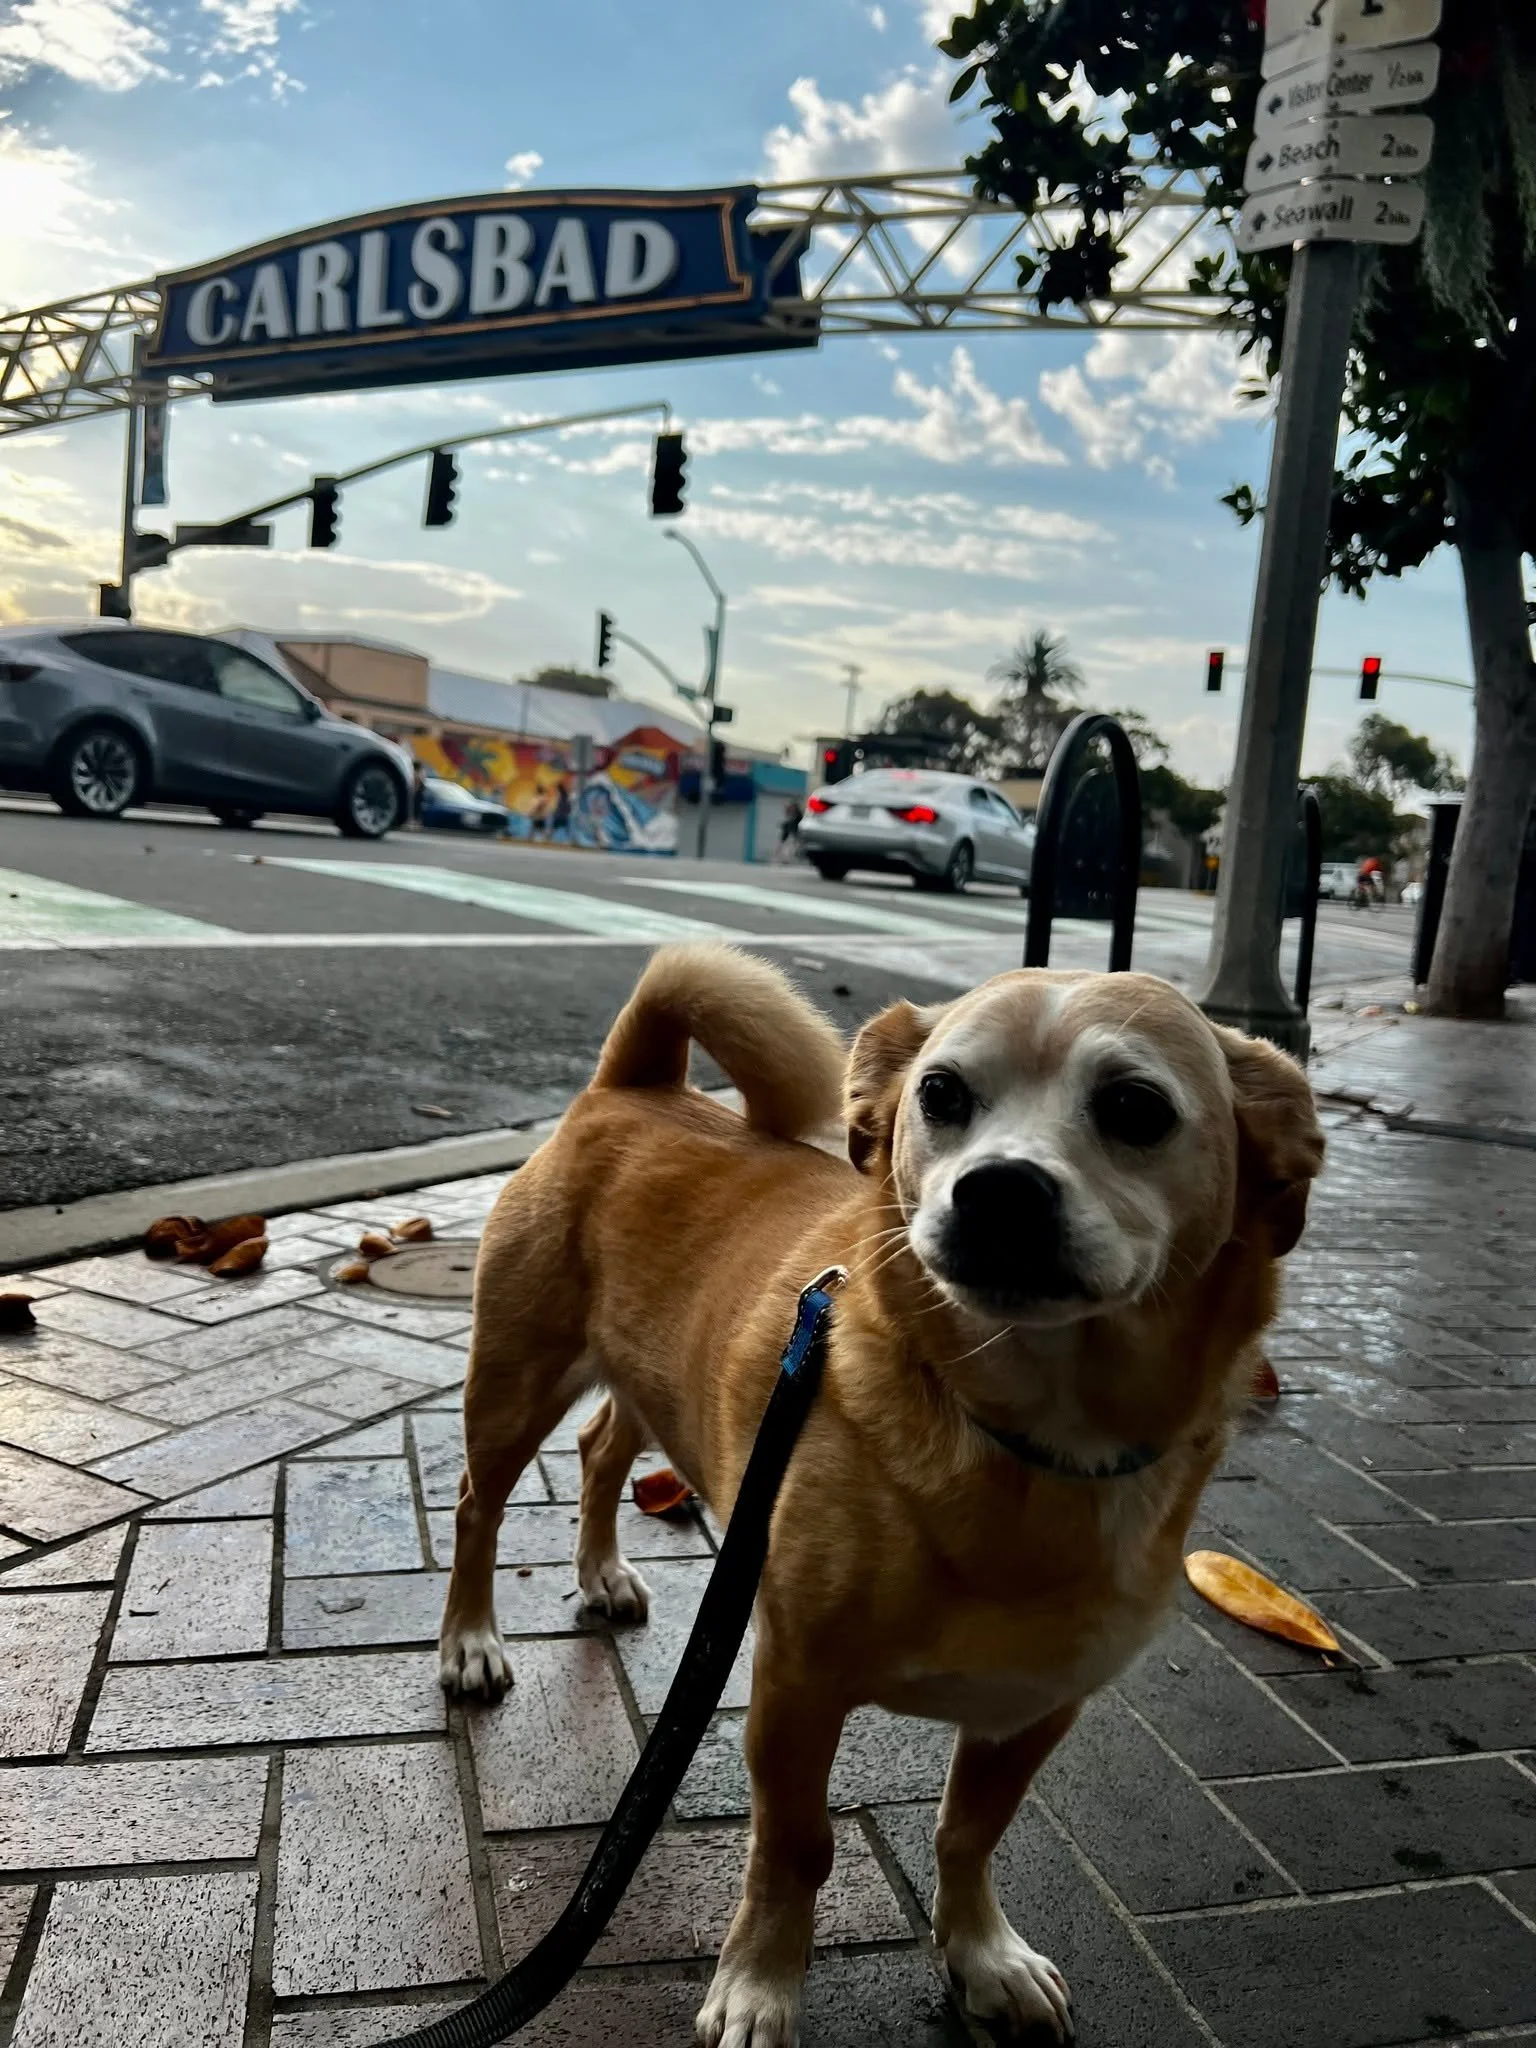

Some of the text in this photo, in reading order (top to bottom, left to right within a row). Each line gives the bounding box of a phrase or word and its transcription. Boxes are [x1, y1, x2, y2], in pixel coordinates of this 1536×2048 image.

[1326, 72, 1373, 97] Center
[1278, 133, 1340, 168] Beach
[1272, 195, 1354, 230] Seawall
[184, 213, 678, 347] CARLSBAD
